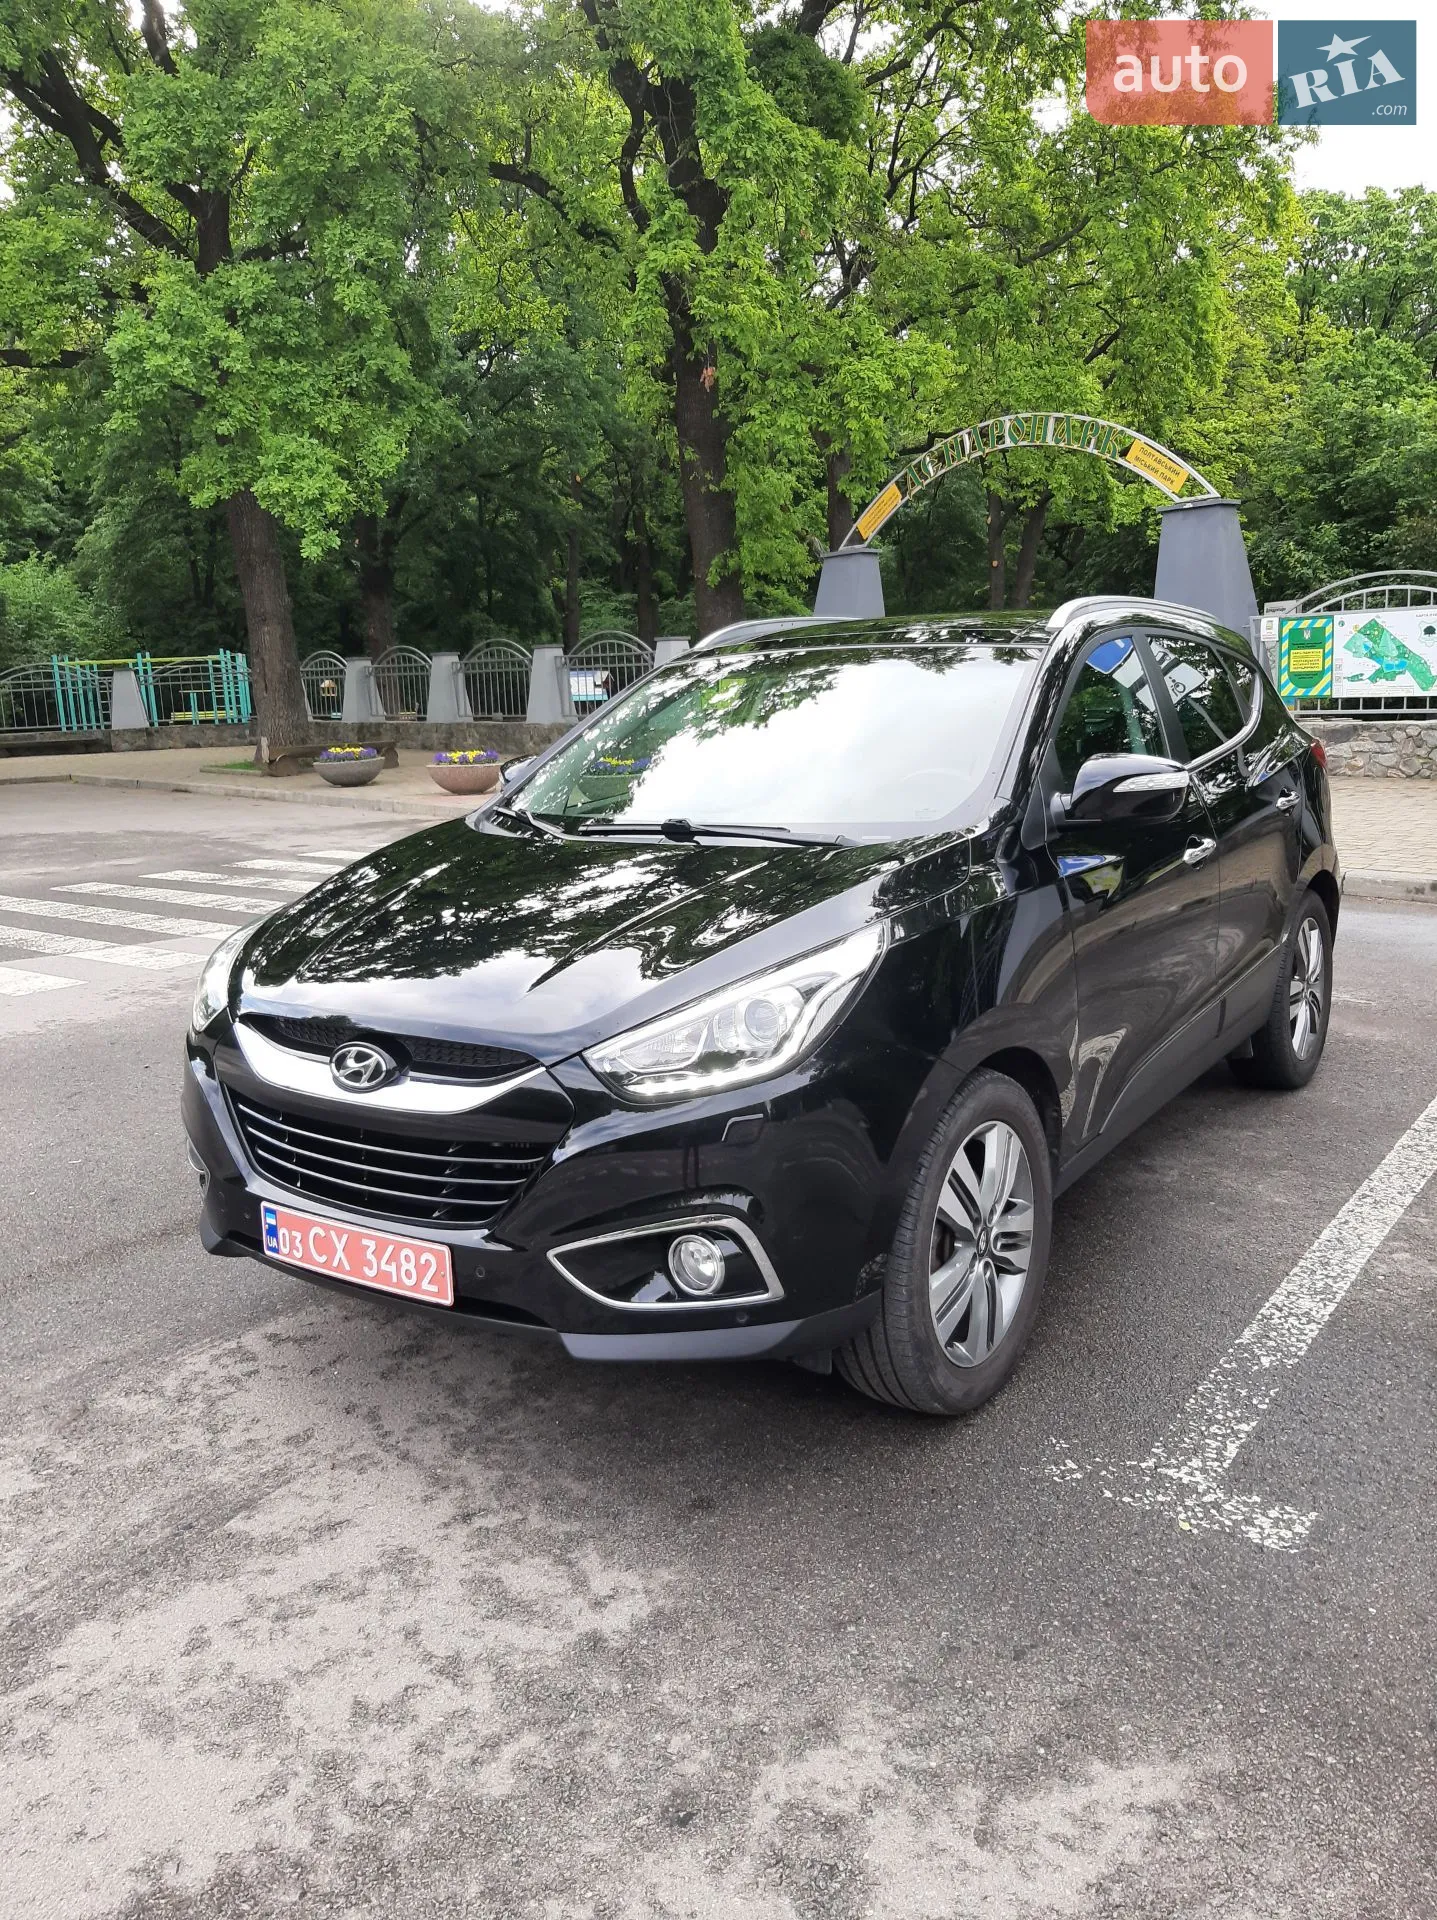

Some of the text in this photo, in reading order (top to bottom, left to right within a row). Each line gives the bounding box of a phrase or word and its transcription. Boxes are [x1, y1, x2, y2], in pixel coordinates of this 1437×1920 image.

[1134, 456, 1174, 485] МІСЬКИЙ ПАРК
[1139, 447, 1180, 477] ПОЛТАВСЬКИЙ
[268, 1236, 278, 1248] UA
[360, 1238, 439, 1293] 3482
